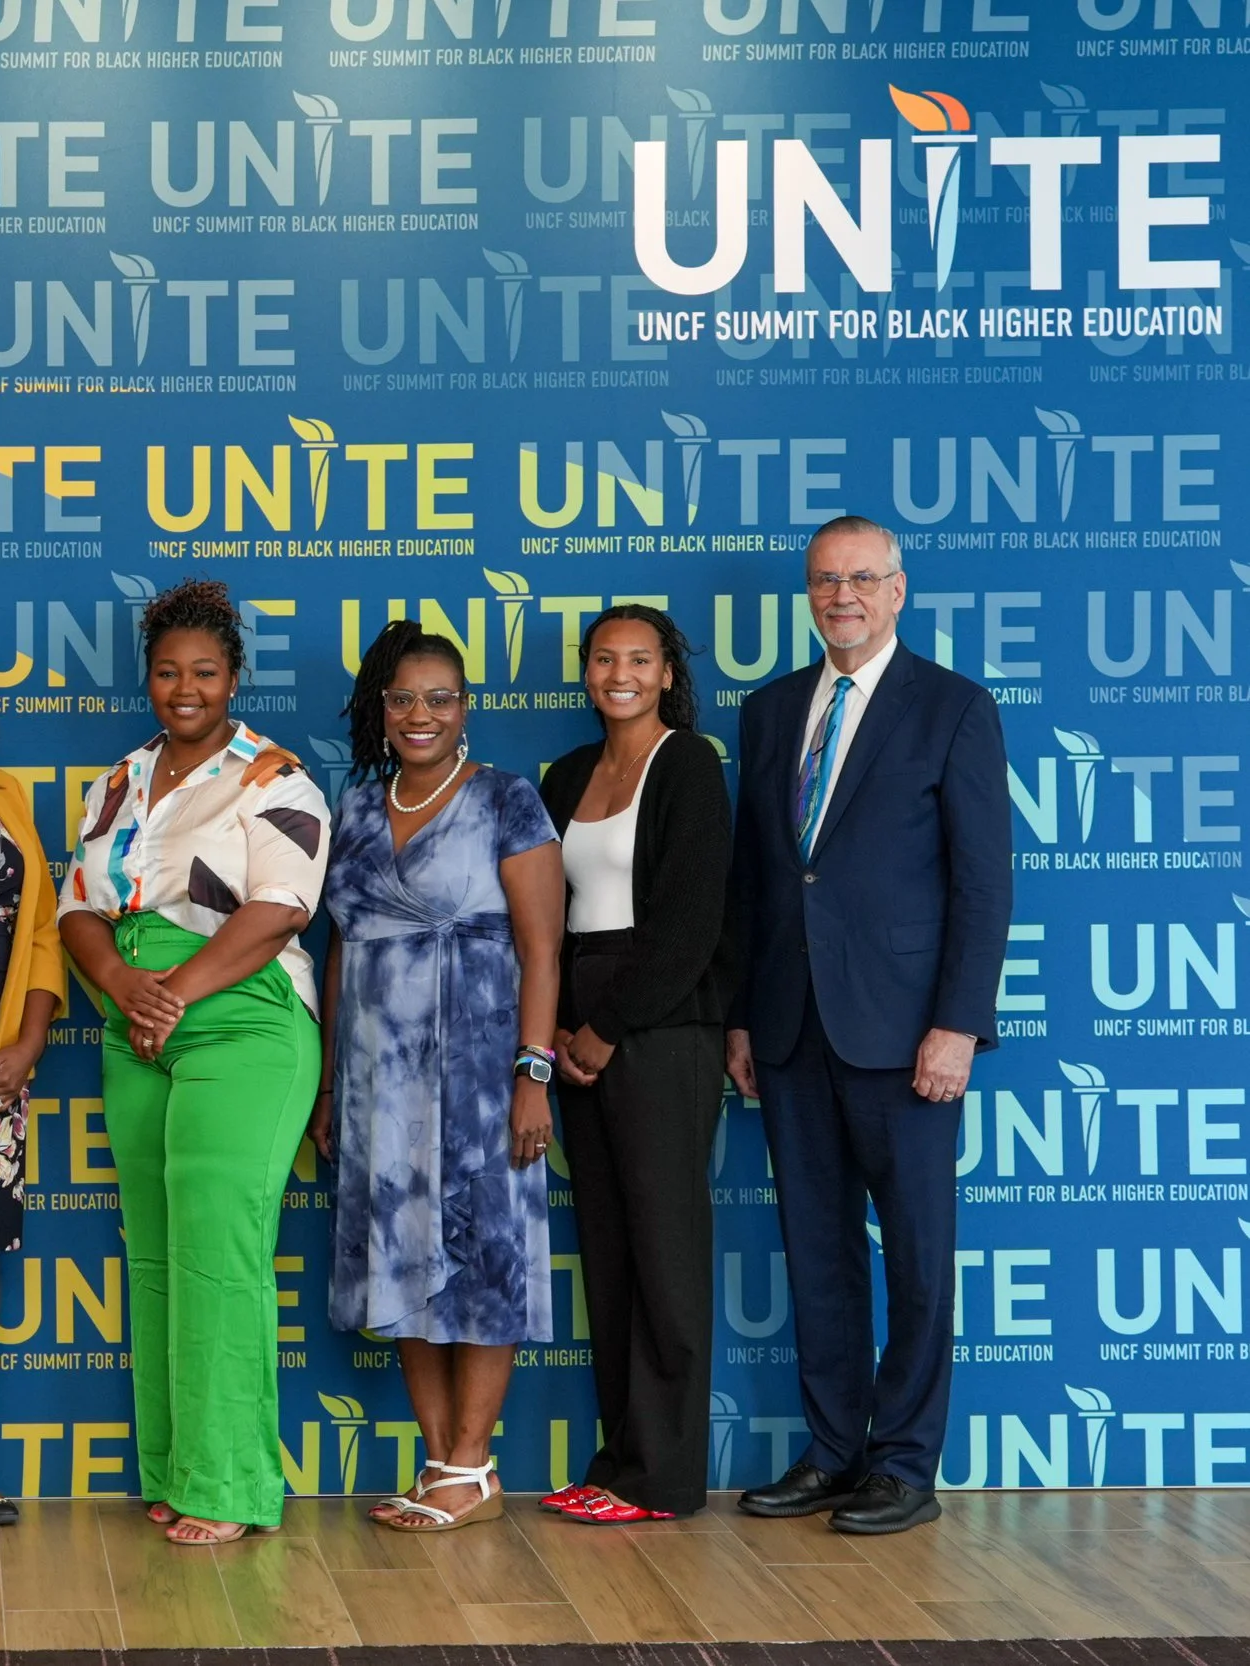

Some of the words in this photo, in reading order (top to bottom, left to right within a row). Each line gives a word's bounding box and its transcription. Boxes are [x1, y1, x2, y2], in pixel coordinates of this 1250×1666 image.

[702, 44, 741, 62] UNCF
[745, 43, 804, 61] SUMMIT
[809, 43, 837, 60] FOR
[842, 43, 888, 60] BLACK
[893, 42, 946, 59] HIGHER
[951, 41, 1030, 59] EDUCATION
[151, 90, 478, 207] UNITE
[634, 83, 1221, 295] UNITE
[27, 216, 107, 234] EDUCATION
[152, 216, 191, 233] UNCF
[195, 216, 253, 233] SUMMIT
[258, 215, 286, 233] FOR
[291, 215, 338, 232] BLACK
[342, 214, 396, 232] HIGHER
[400, 213, 479, 231] EDUCATION
[637, 310, 706, 343] UNCF
[715, 309, 818, 342] SUMMIT
[829, 309, 878, 340] FOR
[888, 308, 969, 340] BLACK
[979, 307, 1074, 338] HIGHER
[1083, 305, 1223, 337] EDUCATION
[147, 414, 473, 533] UNITE
[520, 409, 846, 527] UNITE
[892, 406, 1220, 523] UNITE
[148, 541, 187, 558] UNCF
[192, 540, 250, 558] SUMMIT
[255, 540, 283, 558] FOR
[288, 540, 334, 557] BLACK
[339, 539, 392, 557] HIGHER
[397, 538, 476, 556] EDUCATION
[937, 532, 995, 550] SUMMIT
[1001, 532, 1029, 549] FOR
[1034, 531, 1080, 549] BLACK
[1084, 531, 1138, 549] HIGHER
[1142, 530, 1222, 548] EDUCATION
[15, 697, 73, 714] SUMMIT
[79, 696, 105, 713] FOR
[482, 693, 527, 710] BLACK
[534, 693, 586, 709] HIGHER
[1090, 687, 1127, 704] UNCF
[1133, 687, 1190, 703] SUMMIT
[1196, 686, 1222, 702] FOR
[1007, 726, 1241, 843] NITE
[1022, 853, 1049, 870] FOR
[1055, 852, 1100, 869] BLACK
[1106, 852, 1158, 869] HIGHER
[1164, 851, 1242, 869] EDUCATION
[1094, 1019, 1132, 1037] UNCF
[1137, 1019, 1195, 1036] SUMMIT
[1201, 1019, 1227, 1036] FOR
[965, 1185, 1023, 1203] SUMMIT
[1028, 1185, 1055, 1202] FOR
[1061, 1184, 1107, 1202] BLACK
[1112, 1184, 1164, 1201] HIGHER
[1170, 1183, 1248, 1201] EDUCATION
[23, 1353, 81, 1370] SUMMIT
[87, 1352, 114, 1370] FOR
[354, 1351, 391, 1368] UNCF
[727, 1346, 765, 1364] UNCF
[975, 1344, 1053, 1363] EDUCATION
[1100, 1343, 1138, 1361] UNCF
[1143, 1342, 1201, 1360] SUMMIT
[1206, 1342, 1234, 1360] FOR
